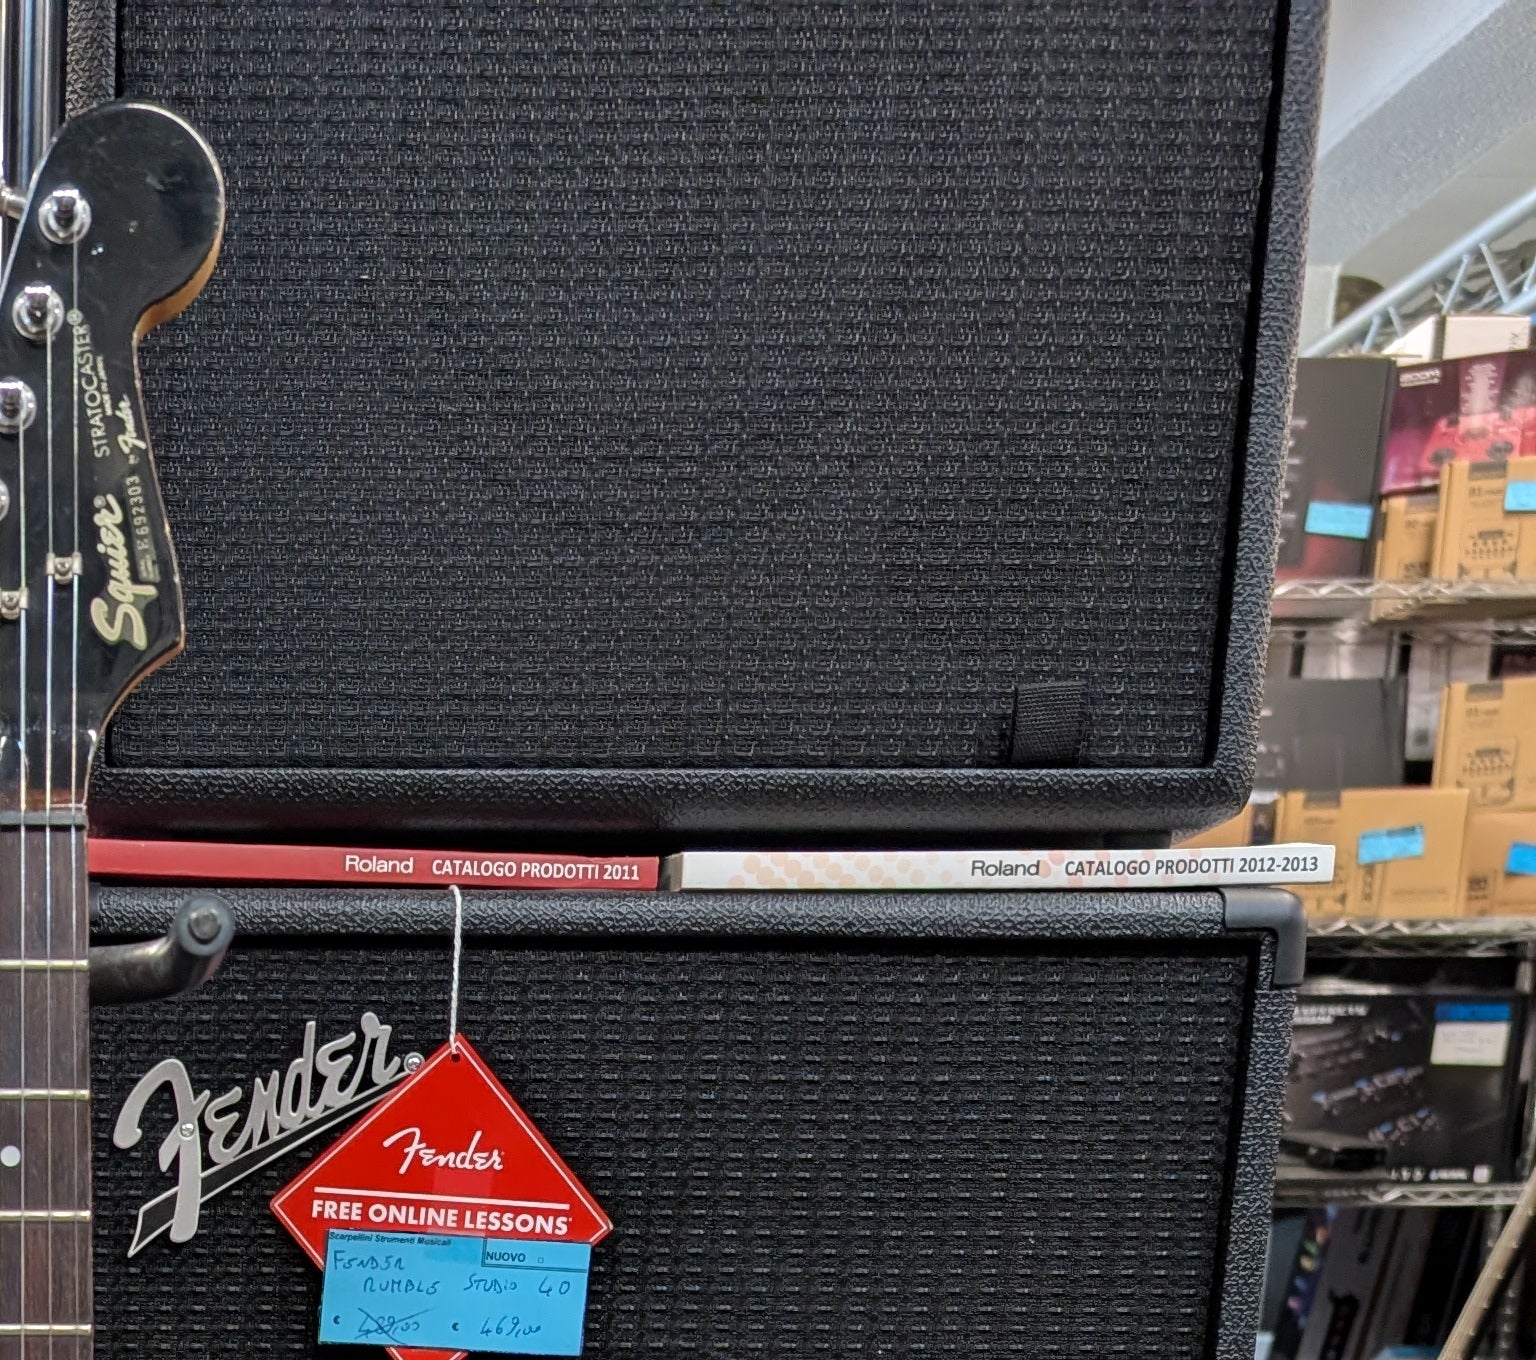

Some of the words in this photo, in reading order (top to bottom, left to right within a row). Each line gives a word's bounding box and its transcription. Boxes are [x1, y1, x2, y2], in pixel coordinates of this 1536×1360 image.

[73, 324, 110, 458] STRATOCASTER
[115, 394, 146, 455] Fender
[90, 493, 158, 651] Squier
[345, 854, 414, 875] Roland
[432, 858, 517, 878] CATALOGO
[520, 860, 600, 880] PRODOTTI
[603, 862, 640, 881] 2011
[972, 857, 1040, 877] Roland
[1065, 857, 1150, 877] CATALOGO
[1154, 856, 1235, 876] PRODOTTI
[1238, 855, 1318, 874] 2012-2013
[112, 1011, 403, 1244] Fender
[383, 1127, 504, 1174] Fender
[311, 1199, 362, 1222] FREE
[368, 1202, 459, 1229] ONLINE
[463, 1208, 571, 1236] LESSONS
[329, 1231, 373, 1244] Scarpellini
[486, 1249, 526, 1264] NUOVO
[538, 1274, 571, 1297] 40
